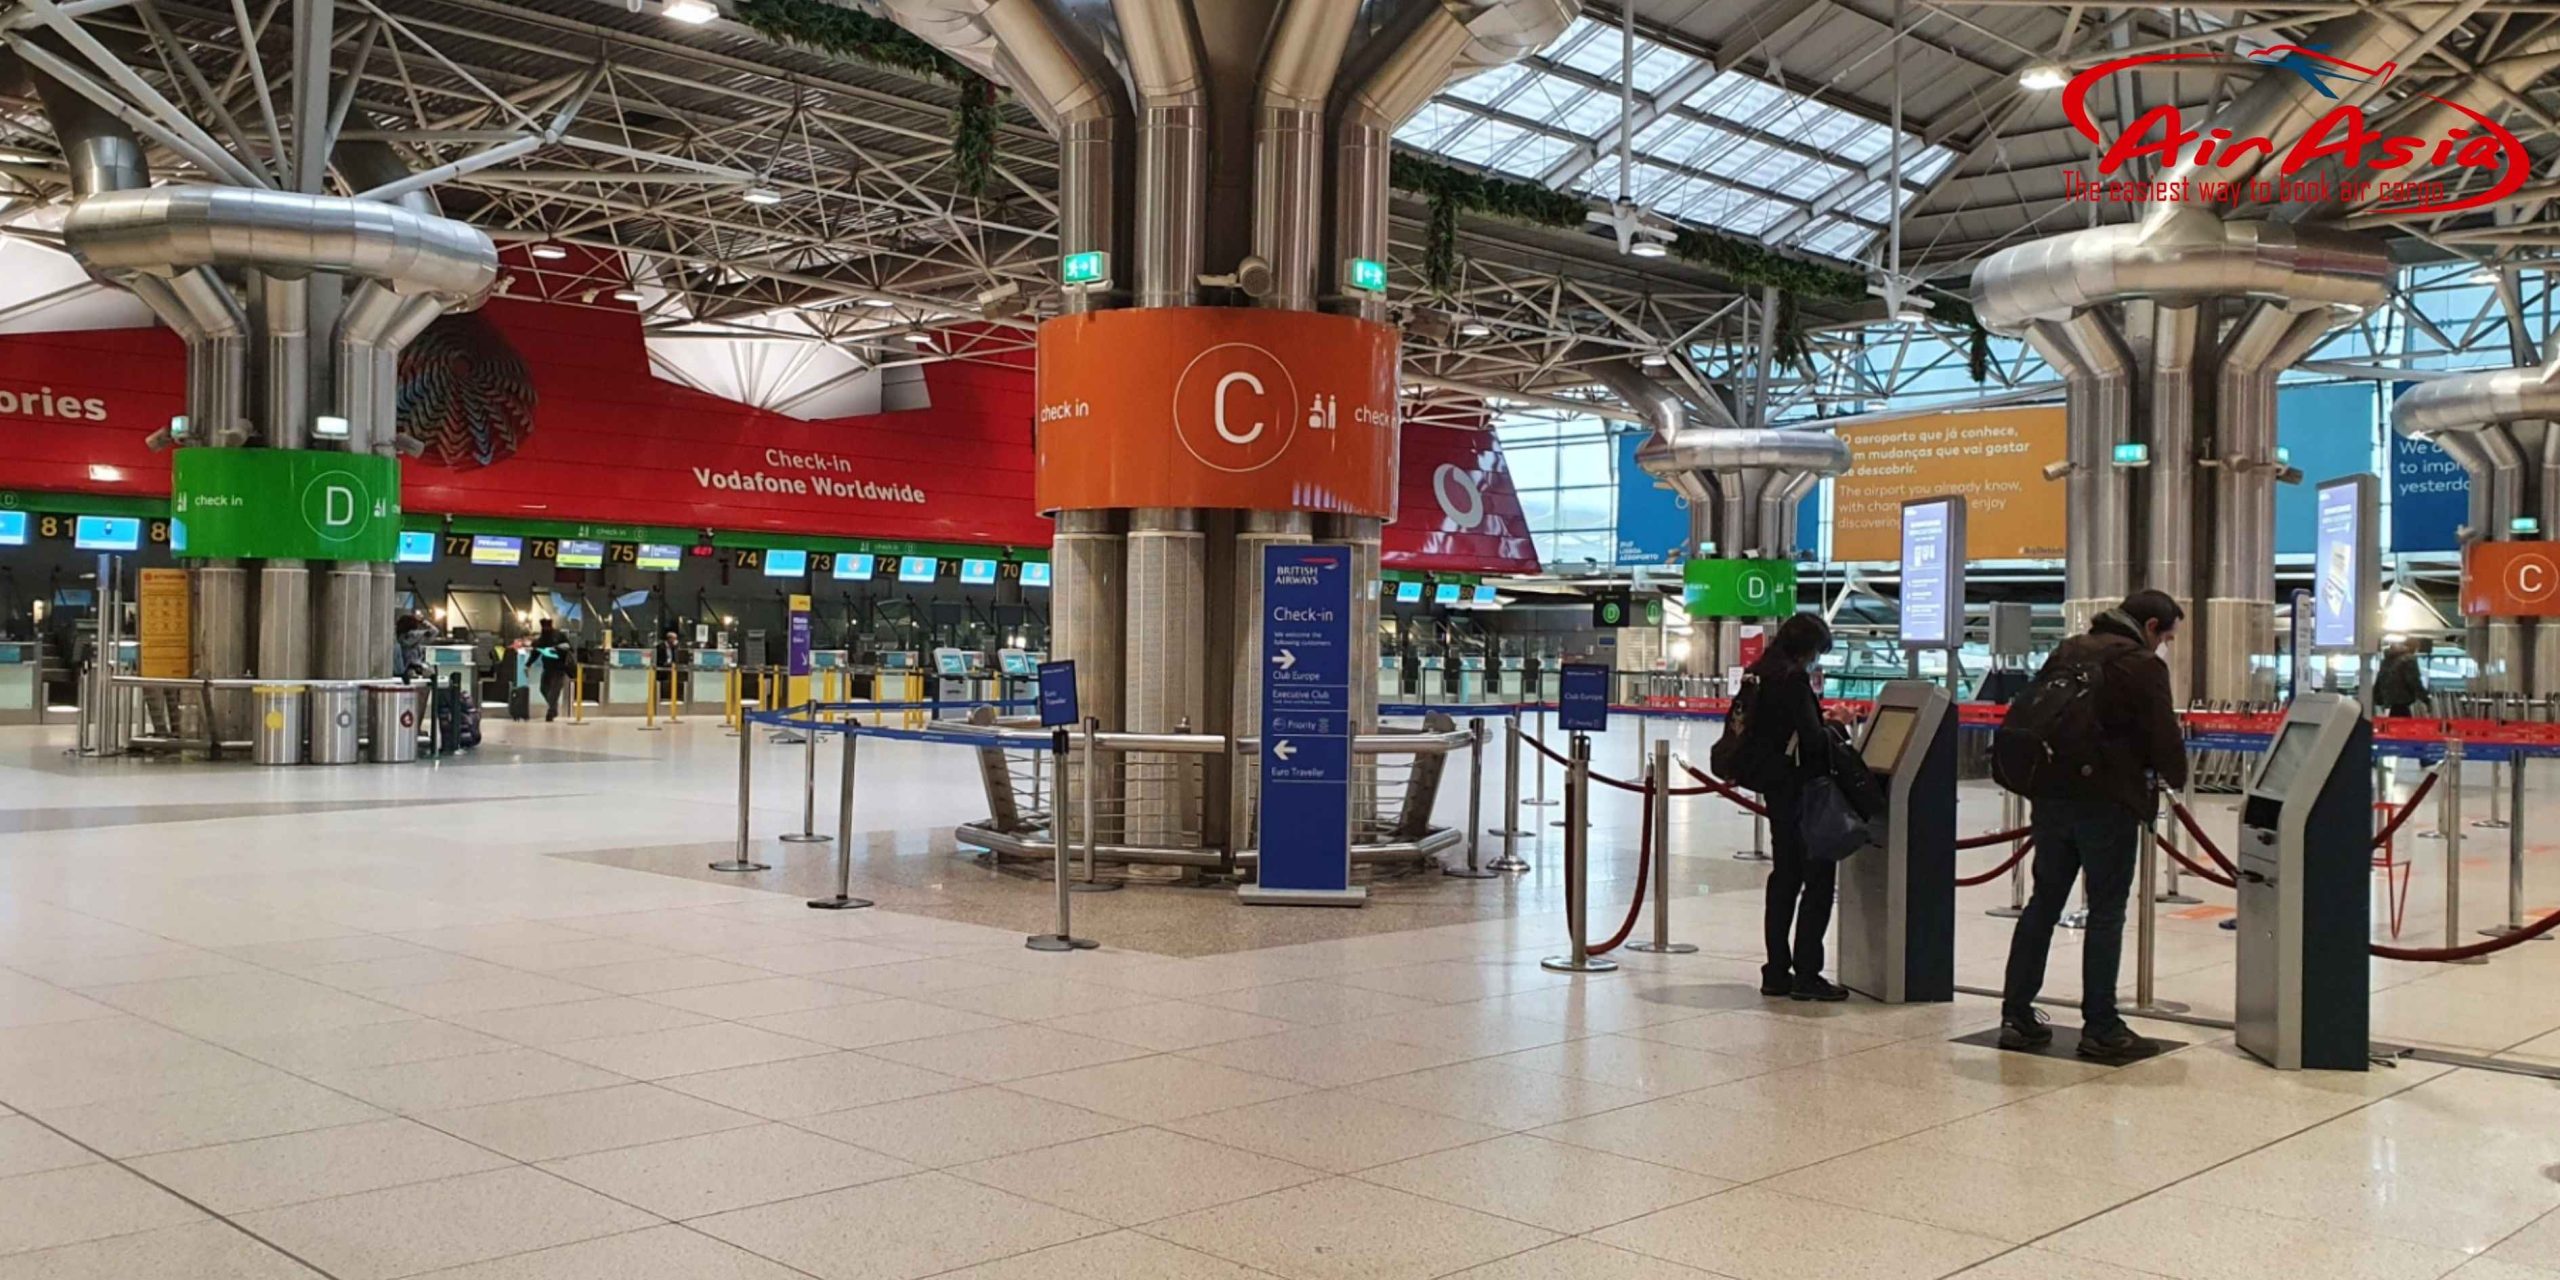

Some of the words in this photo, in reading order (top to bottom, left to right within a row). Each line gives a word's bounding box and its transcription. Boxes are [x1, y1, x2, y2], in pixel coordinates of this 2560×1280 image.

[0, 386, 107, 421] ories
[1041, 400, 1072, 422] check
[1075, 398, 1089, 417] in
[1215, 371, 1264, 444] C
[1854, 431, 1916, 445] aeroporto
[1919, 430, 1943, 443] que
[1945, 426, 1957, 443] já
[1961, 425, 2018, 439] conhece,
[1868, 446, 1932, 460] mudanças
[1936, 446, 1960, 459] que
[1963, 442, 1982, 455] vai
[1985, 442, 2030, 456] gostar
[2400, 440, 2427, 454] We
[766, 448, 852, 473] Check-in
[2400, 462, 2418, 474] to
[1857, 461, 1917, 477] descobrir.
[693, 467, 807, 494] Vodafone
[811, 475, 926, 503] Worldwide
[1839, 485, 1861, 496] The
[1864, 484, 1905, 497] airport
[1909, 484, 1931, 497] you
[1934, 482, 1981, 495] already
[1984, 479, 2022, 492] know,
[194, 494, 228, 506] check
[231, 494, 243, 506] in
[326, 486, 354, 525] D
[1838, 500, 1865, 513] with
[1867, 500, 1900, 513] chan
[1972, 496, 2007, 511] enjoy
[41, 517, 74, 537] 81
[1838, 516, 1900, 530] discoverin
[151, 522, 171, 542] 8
[446, 536, 470, 555] 77
[532, 541, 555, 558] 76
[611, 545, 634, 561] 75
[737, 551, 758, 567] 74
[811, 554, 830, 570] 73
[878, 557, 897, 573] 72
[939, 561, 957, 576] 71
[1002, 563, 1018, 578] 70
[1277, 566, 1318, 576] BRITISH
[1275, 576, 1319, 585] AIRWAYS
[2520, 564, 2542, 592] C
[1383, 582, 1396, 595] 62
[1749, 577, 1764, 598] D
[1273, 606, 1334, 621] Check-in
[1273, 670, 1290, 680] Club
[1292, 670, 1320, 681] Europe
[1273, 689, 1309, 698] Executive
[1311, 690, 1329, 699] Club
[1288, 719, 1316, 730] Priority
[1271, 767, 1289, 776] Euro
[1291, 767, 1324, 776] Traveller
